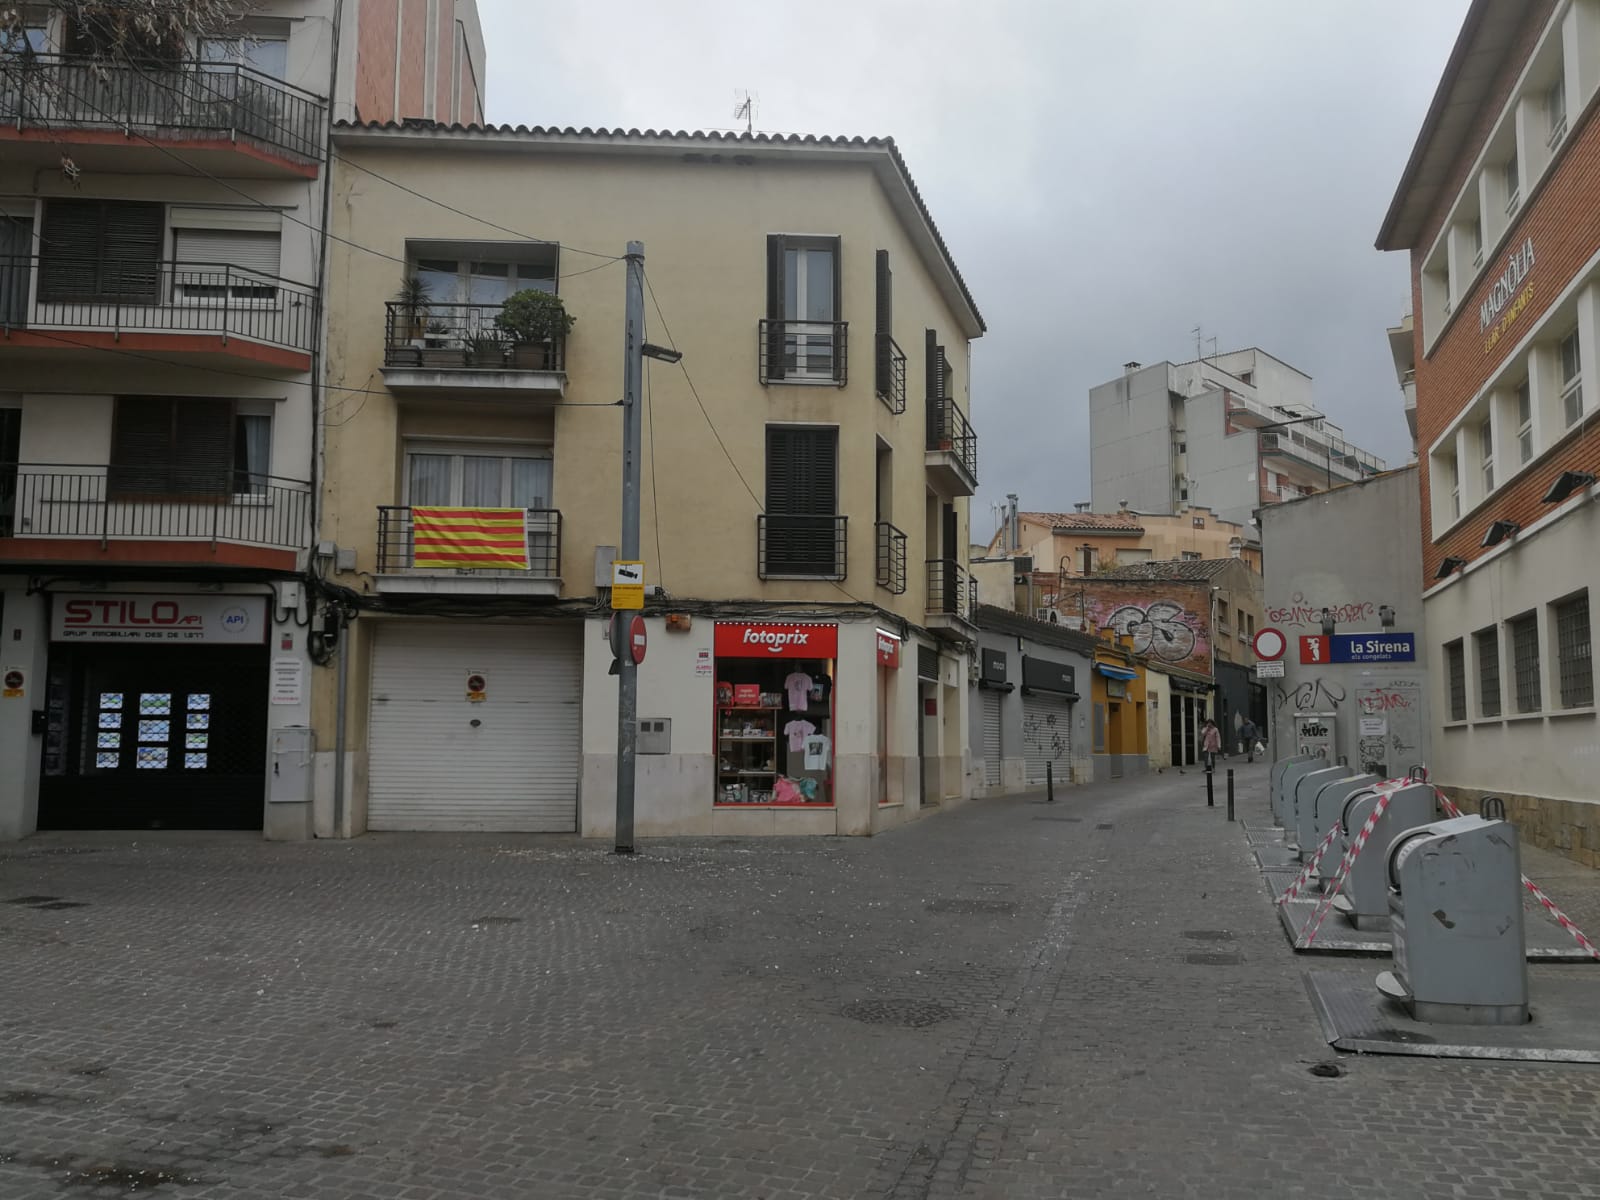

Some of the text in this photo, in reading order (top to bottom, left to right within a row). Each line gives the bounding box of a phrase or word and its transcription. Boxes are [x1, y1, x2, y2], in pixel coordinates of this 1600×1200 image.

[1480, 236, 1536, 334] MAGNÒLIA
[64, 601, 203, 625] STILO API
[226, 615, 244, 625] API
[63, 630, 88, 638] GRUP
[144, 631, 163, 639] DES
[743, 628, 809, 648] fotoprix
[1351, 640, 1411, 654] la Sirena
[1362, 653, 1392, 661] congelats
